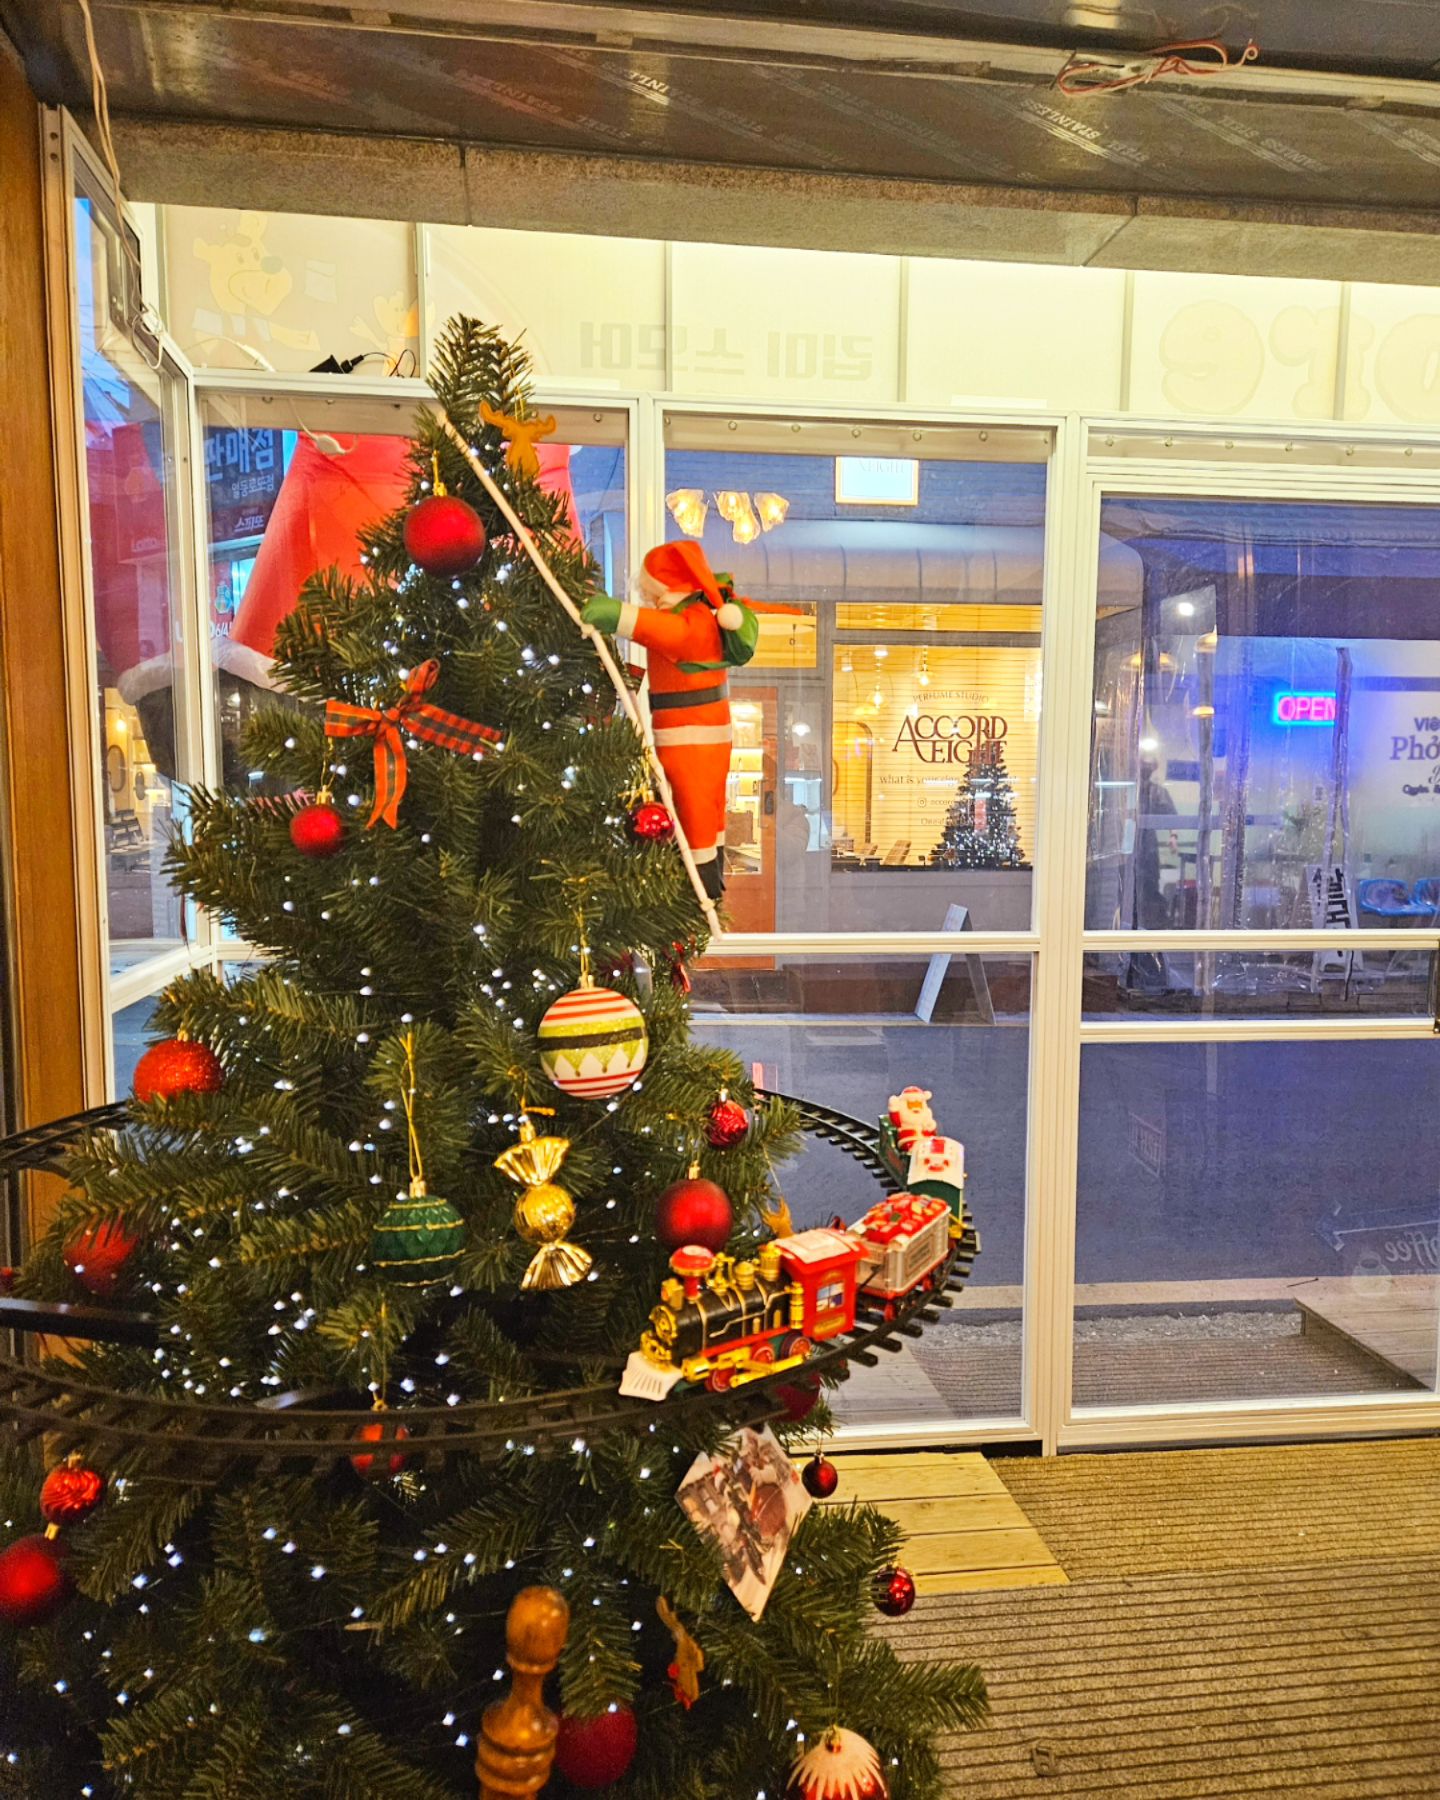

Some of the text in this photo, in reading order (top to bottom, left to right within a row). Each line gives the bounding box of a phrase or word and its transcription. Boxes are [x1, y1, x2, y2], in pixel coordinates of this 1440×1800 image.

[204, 428, 274, 481] 판매점
[892, 715, 1008, 748] ACCORD
[927, 740, 1008, 763] EIGHT
